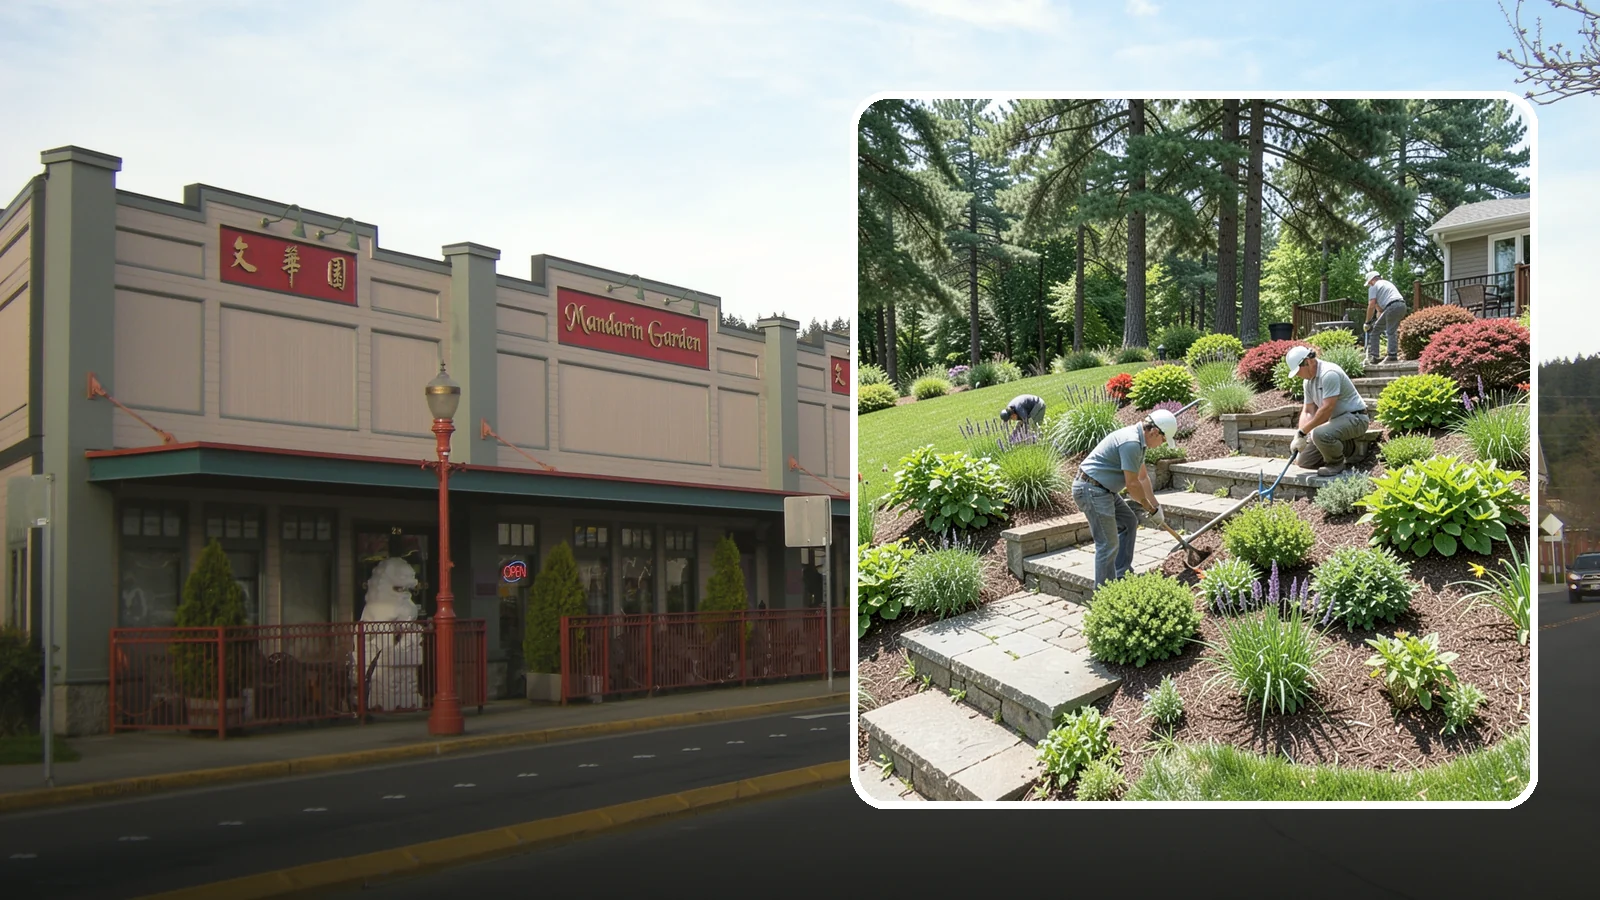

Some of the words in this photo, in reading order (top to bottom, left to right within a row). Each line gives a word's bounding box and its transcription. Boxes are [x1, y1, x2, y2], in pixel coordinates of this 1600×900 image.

[230, 236, 346, 291] 文華園
[564, 302, 644, 341] Mandarin
[648, 320, 702, 352] Garden
[834, 362, 847, 386] 文
[503, 565, 527, 578] OPEN
